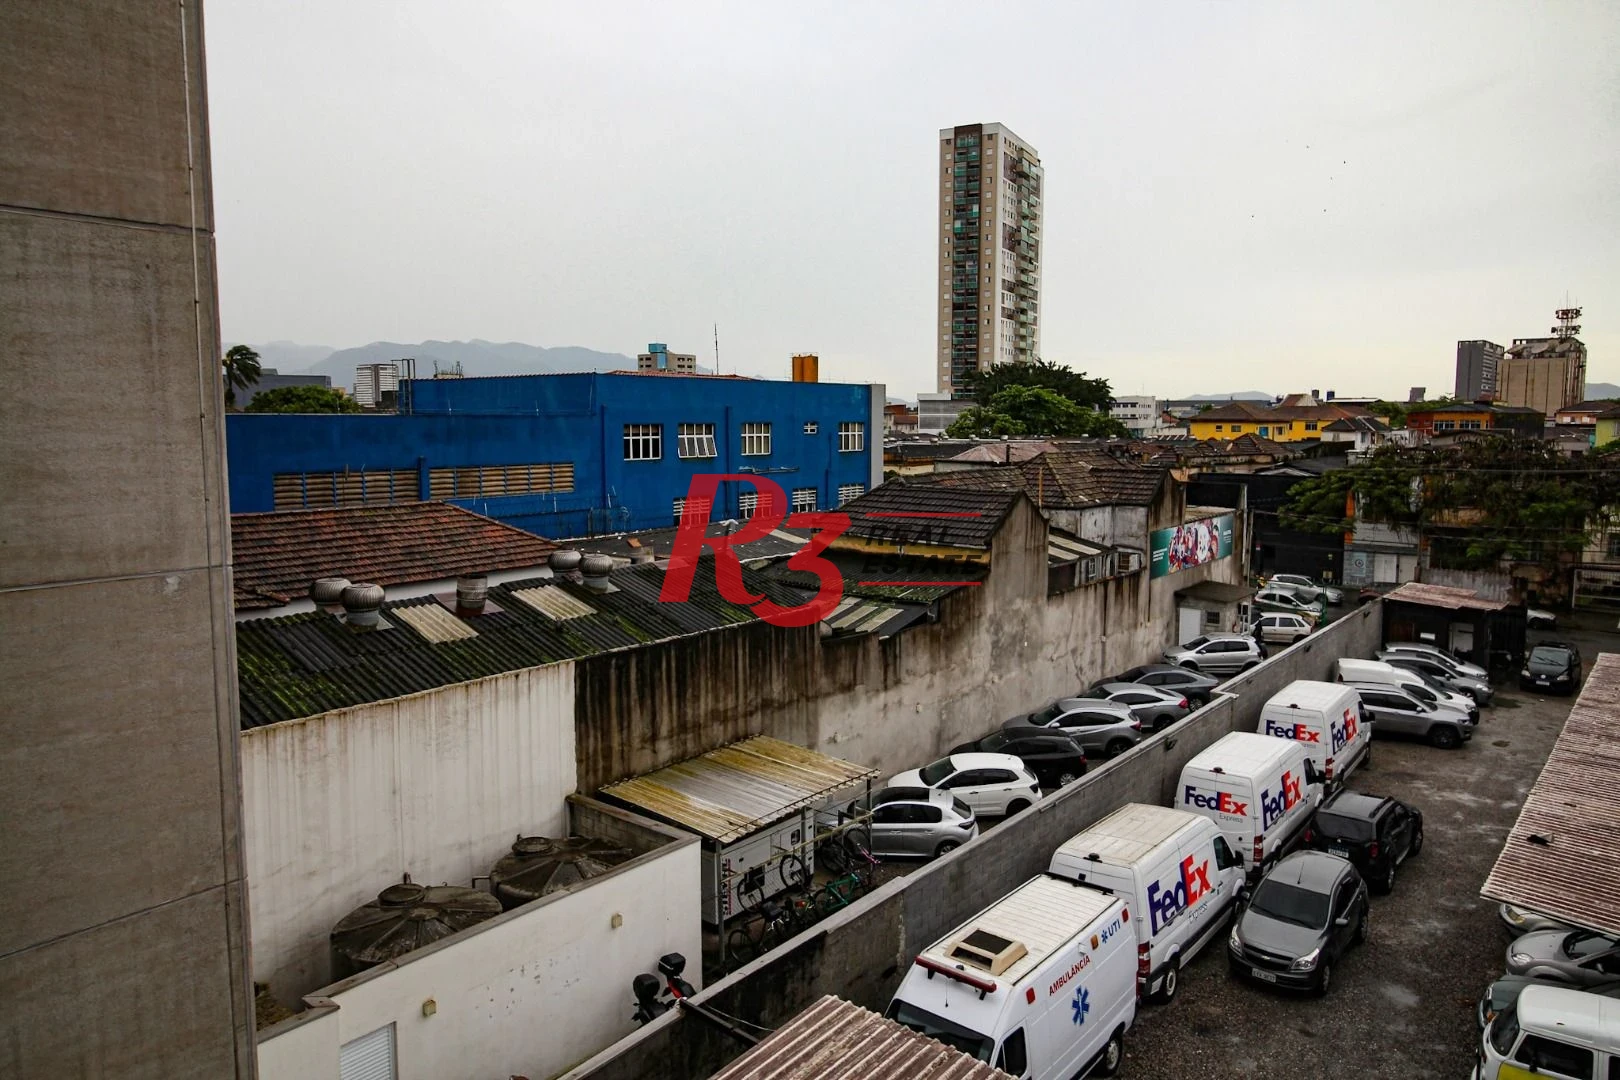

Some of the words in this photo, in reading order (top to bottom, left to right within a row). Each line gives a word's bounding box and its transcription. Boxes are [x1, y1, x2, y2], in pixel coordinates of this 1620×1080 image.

[1265, 719, 1320, 744] FedEx
[1330, 708, 1358, 755] FedEx
[1184, 784, 1249, 816] FedEx
[1260, 770, 1303, 832] FedEx
[1147, 854, 1213, 937] FedEx
[1108, 918, 1121, 937] UTI
